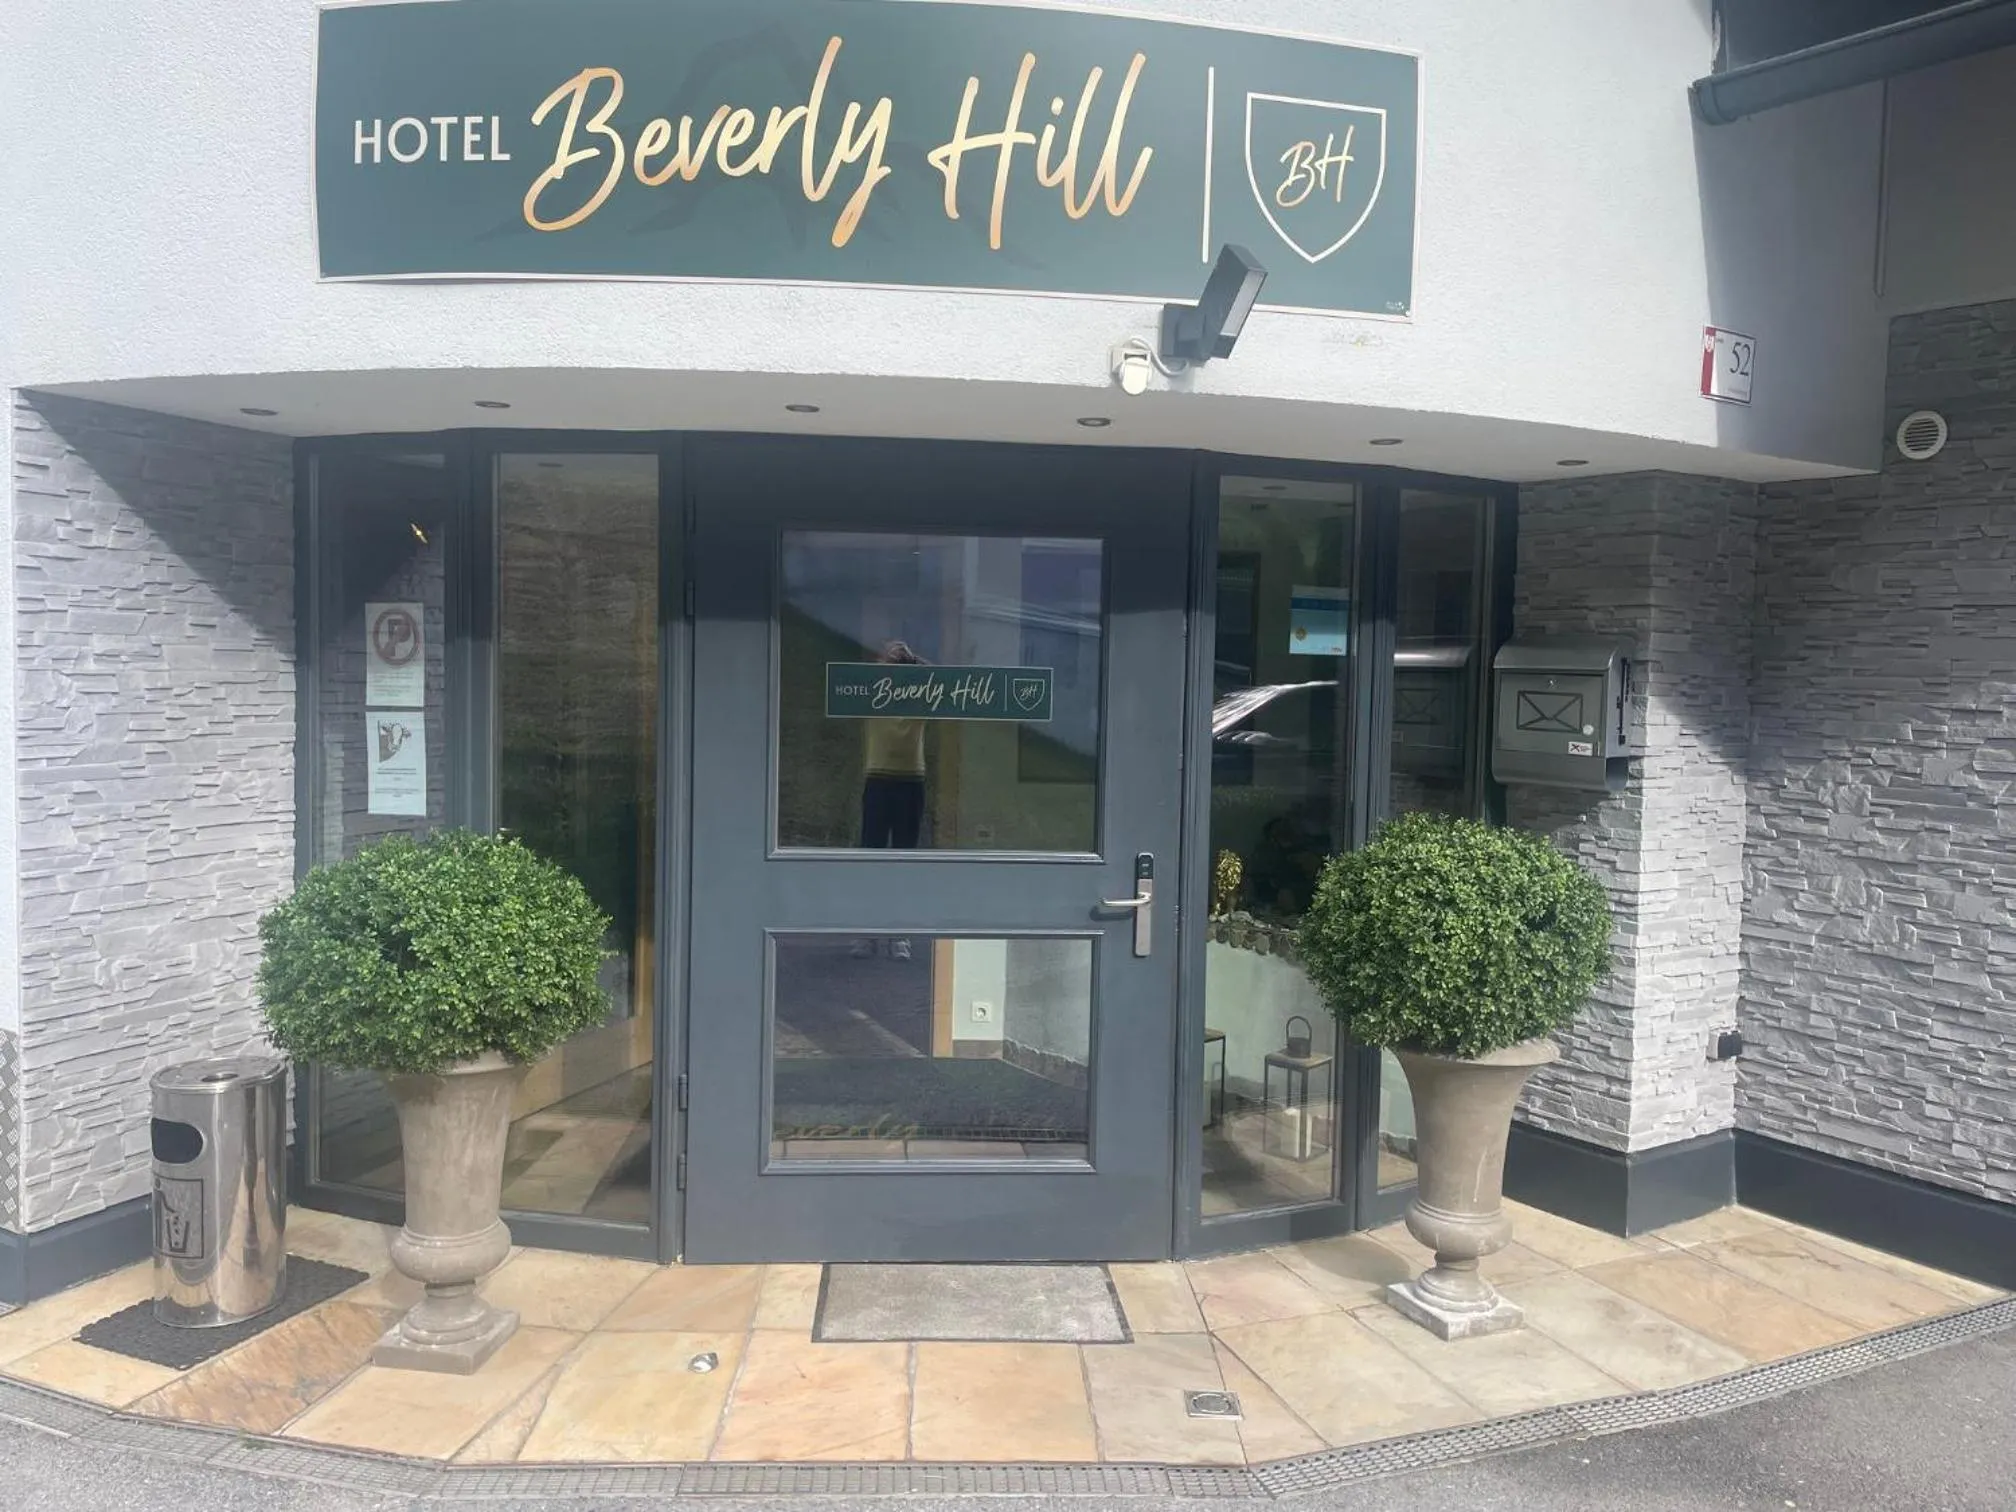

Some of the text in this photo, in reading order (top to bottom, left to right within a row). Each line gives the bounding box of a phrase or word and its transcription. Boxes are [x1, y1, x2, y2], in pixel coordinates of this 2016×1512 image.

[353, 36, 1153, 250] HOTEL Beverly Hill
[1275, 124, 1356, 207] BH
[1729, 341, 1751, 376] 52
[835, 672, 995, 711] HOTEL Beverly Hill
